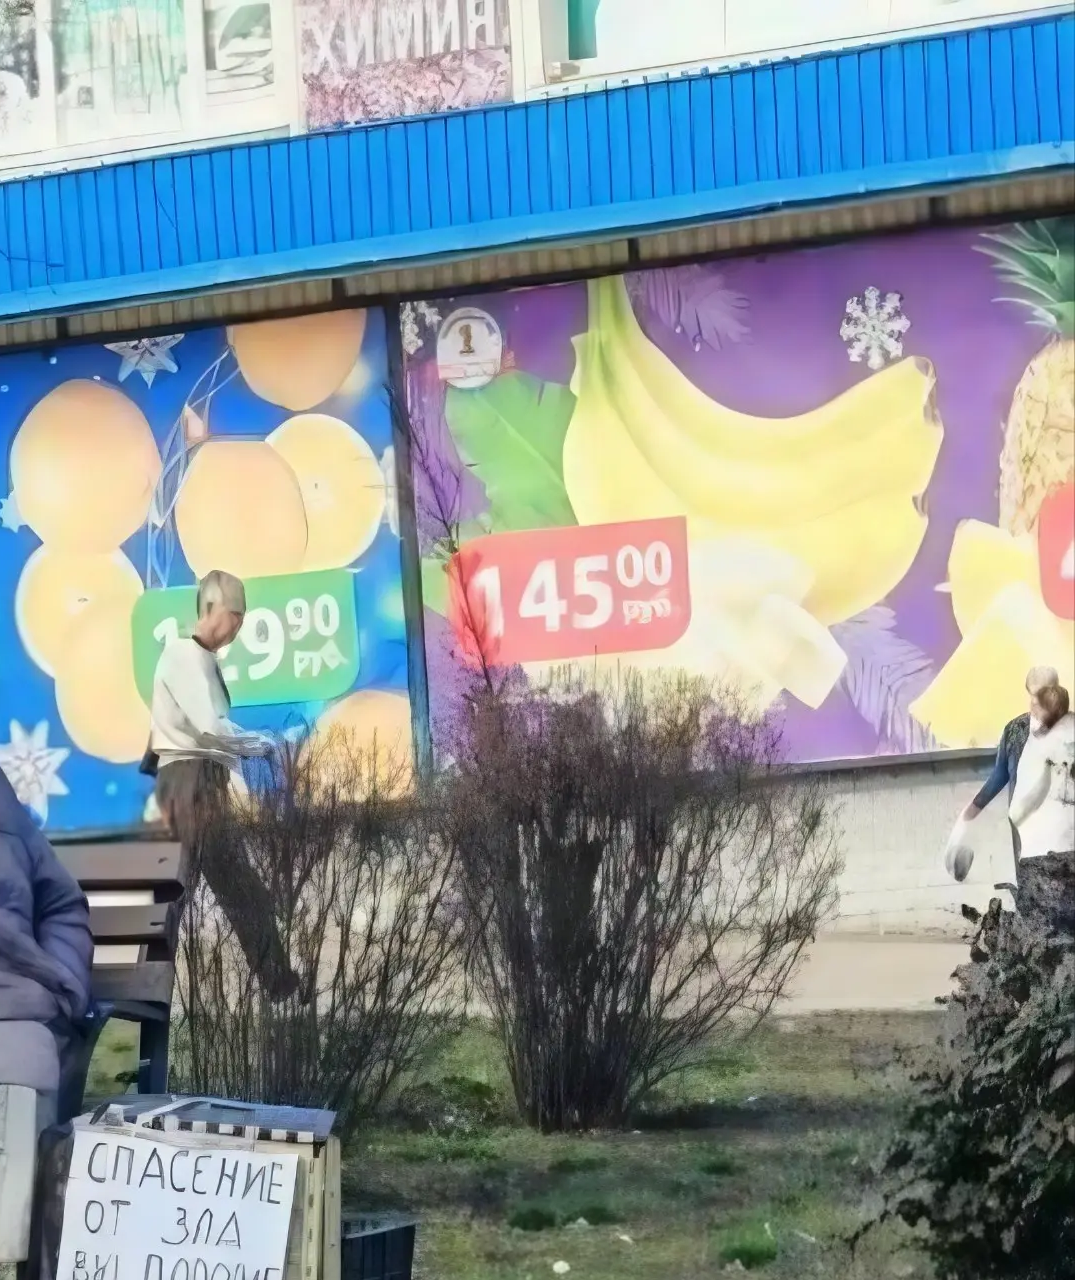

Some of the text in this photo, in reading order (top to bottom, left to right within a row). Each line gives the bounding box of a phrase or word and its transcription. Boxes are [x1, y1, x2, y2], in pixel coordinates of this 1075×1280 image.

[286, 593, 341, 642] 90
[470, 541, 673, 638] 145 00
[87, 1142, 283, 1205] СПАСЕНИЕ
[84, 1199, 242, 1250] ОТ ЗЛА
